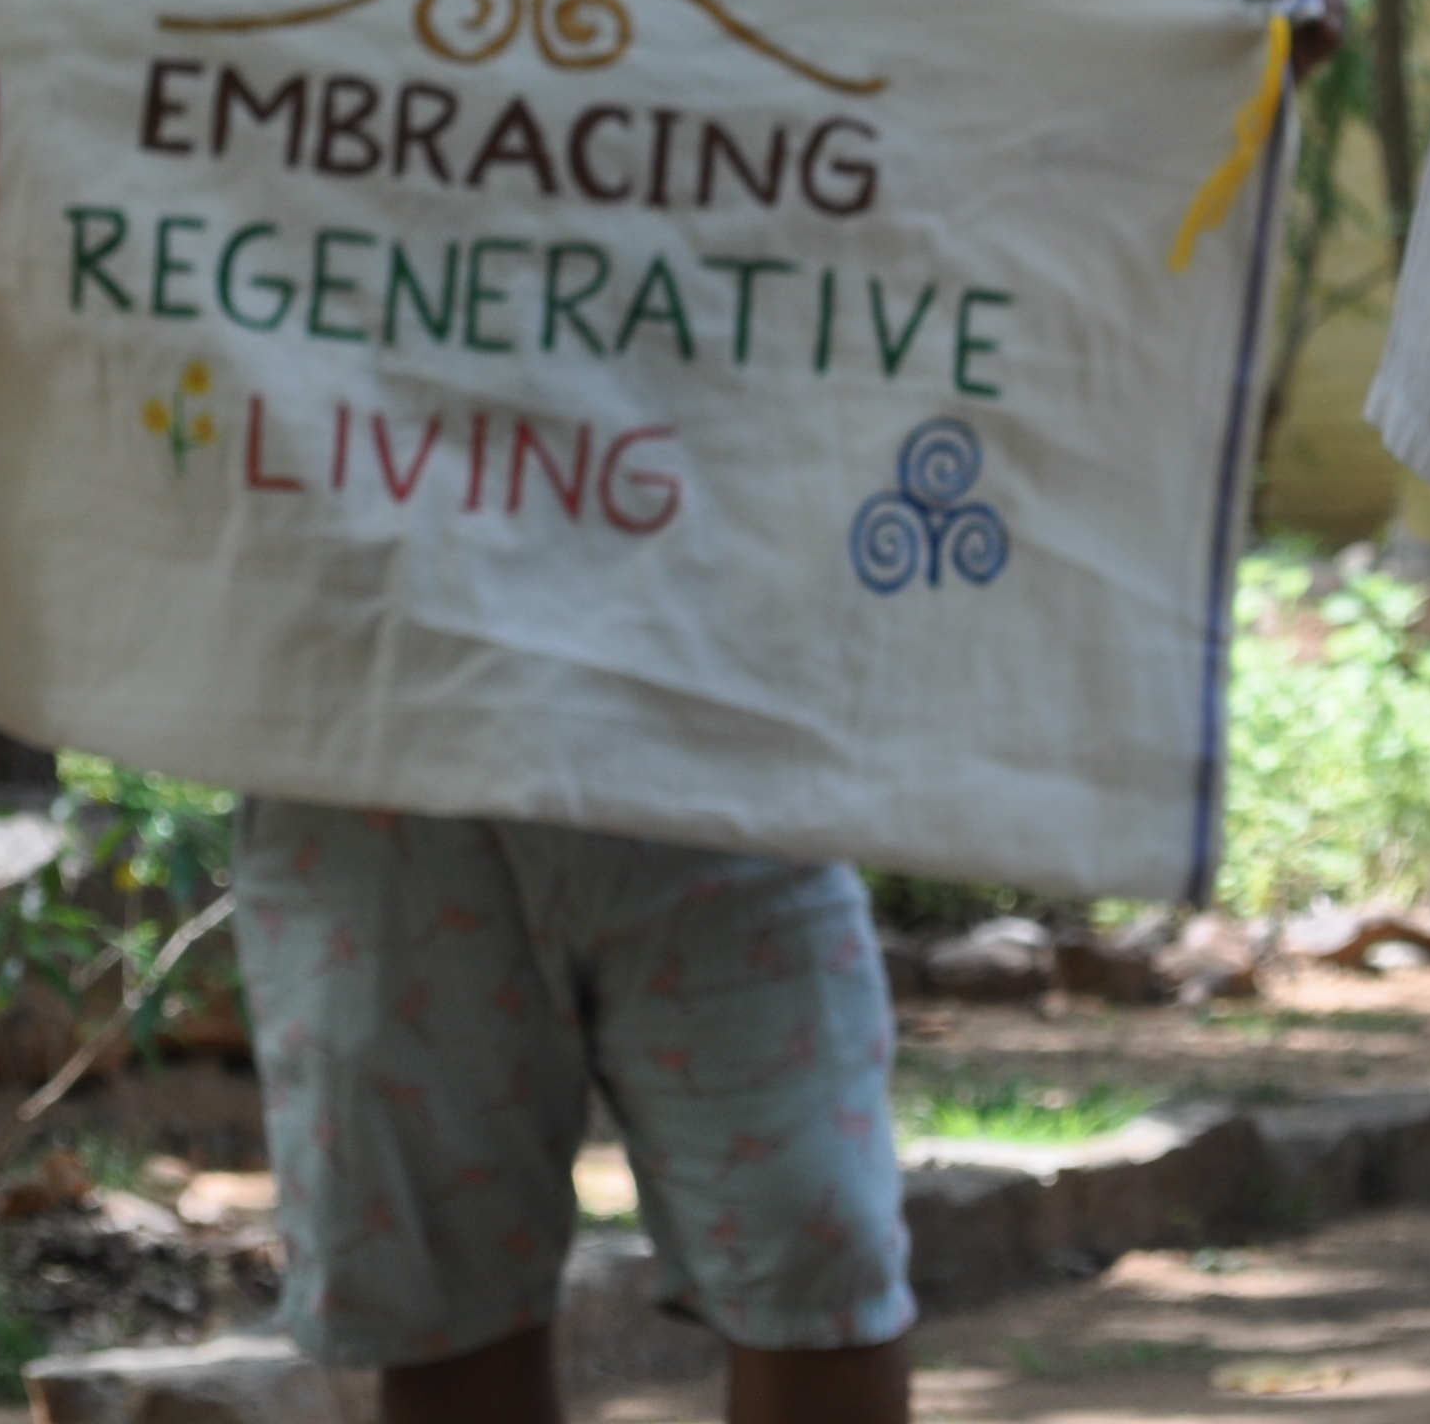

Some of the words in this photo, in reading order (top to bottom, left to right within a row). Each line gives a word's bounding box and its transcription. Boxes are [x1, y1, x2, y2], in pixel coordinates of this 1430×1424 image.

[141, 60, 880, 214] EMBRACING
[68, 207, 1013, 396] REGENERATIVE
[245, 396, 681, 533] LIVING
